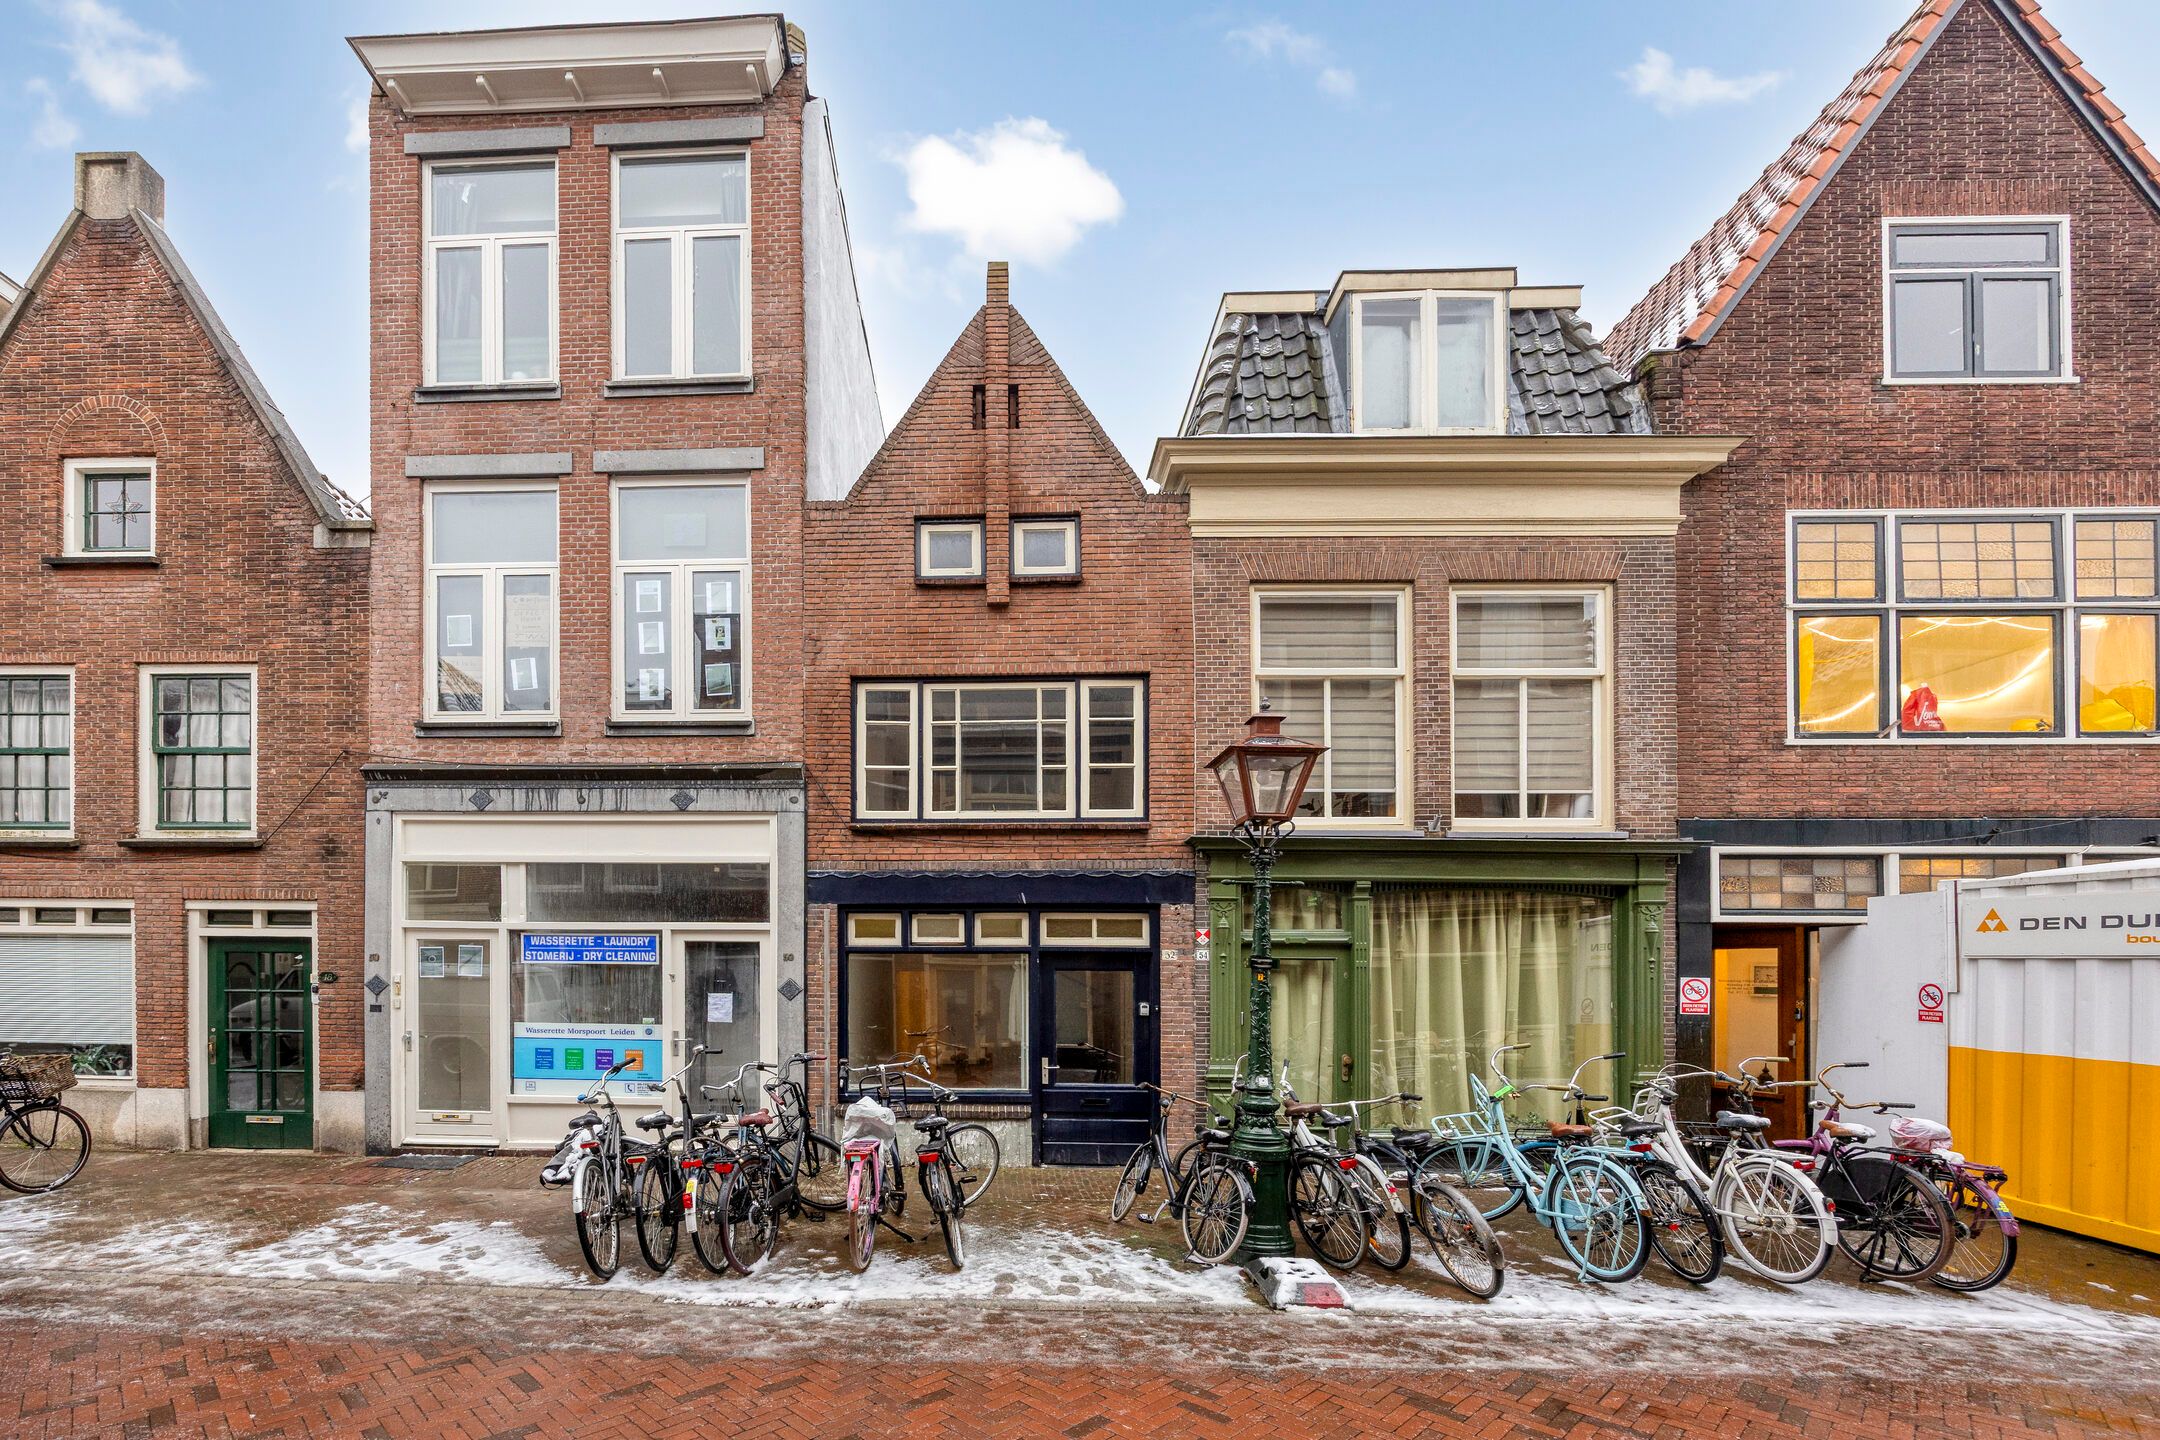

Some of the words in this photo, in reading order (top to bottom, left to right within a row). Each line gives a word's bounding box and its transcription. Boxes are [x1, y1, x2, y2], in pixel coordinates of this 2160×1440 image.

[2019, 916, 2087, 931] DEN
[530, 936, 594, 946] WASSERETTE
[603, 937, 650, 946] LAUNDRY
[525, 951, 575, 961] STOMERIJ
[583, 952, 601, 960] DRY
[605, 952, 656, 961] CLEANING
[1198, 952, 1208, 960] 54
[567, 1028, 606, 1036] Morspoort
